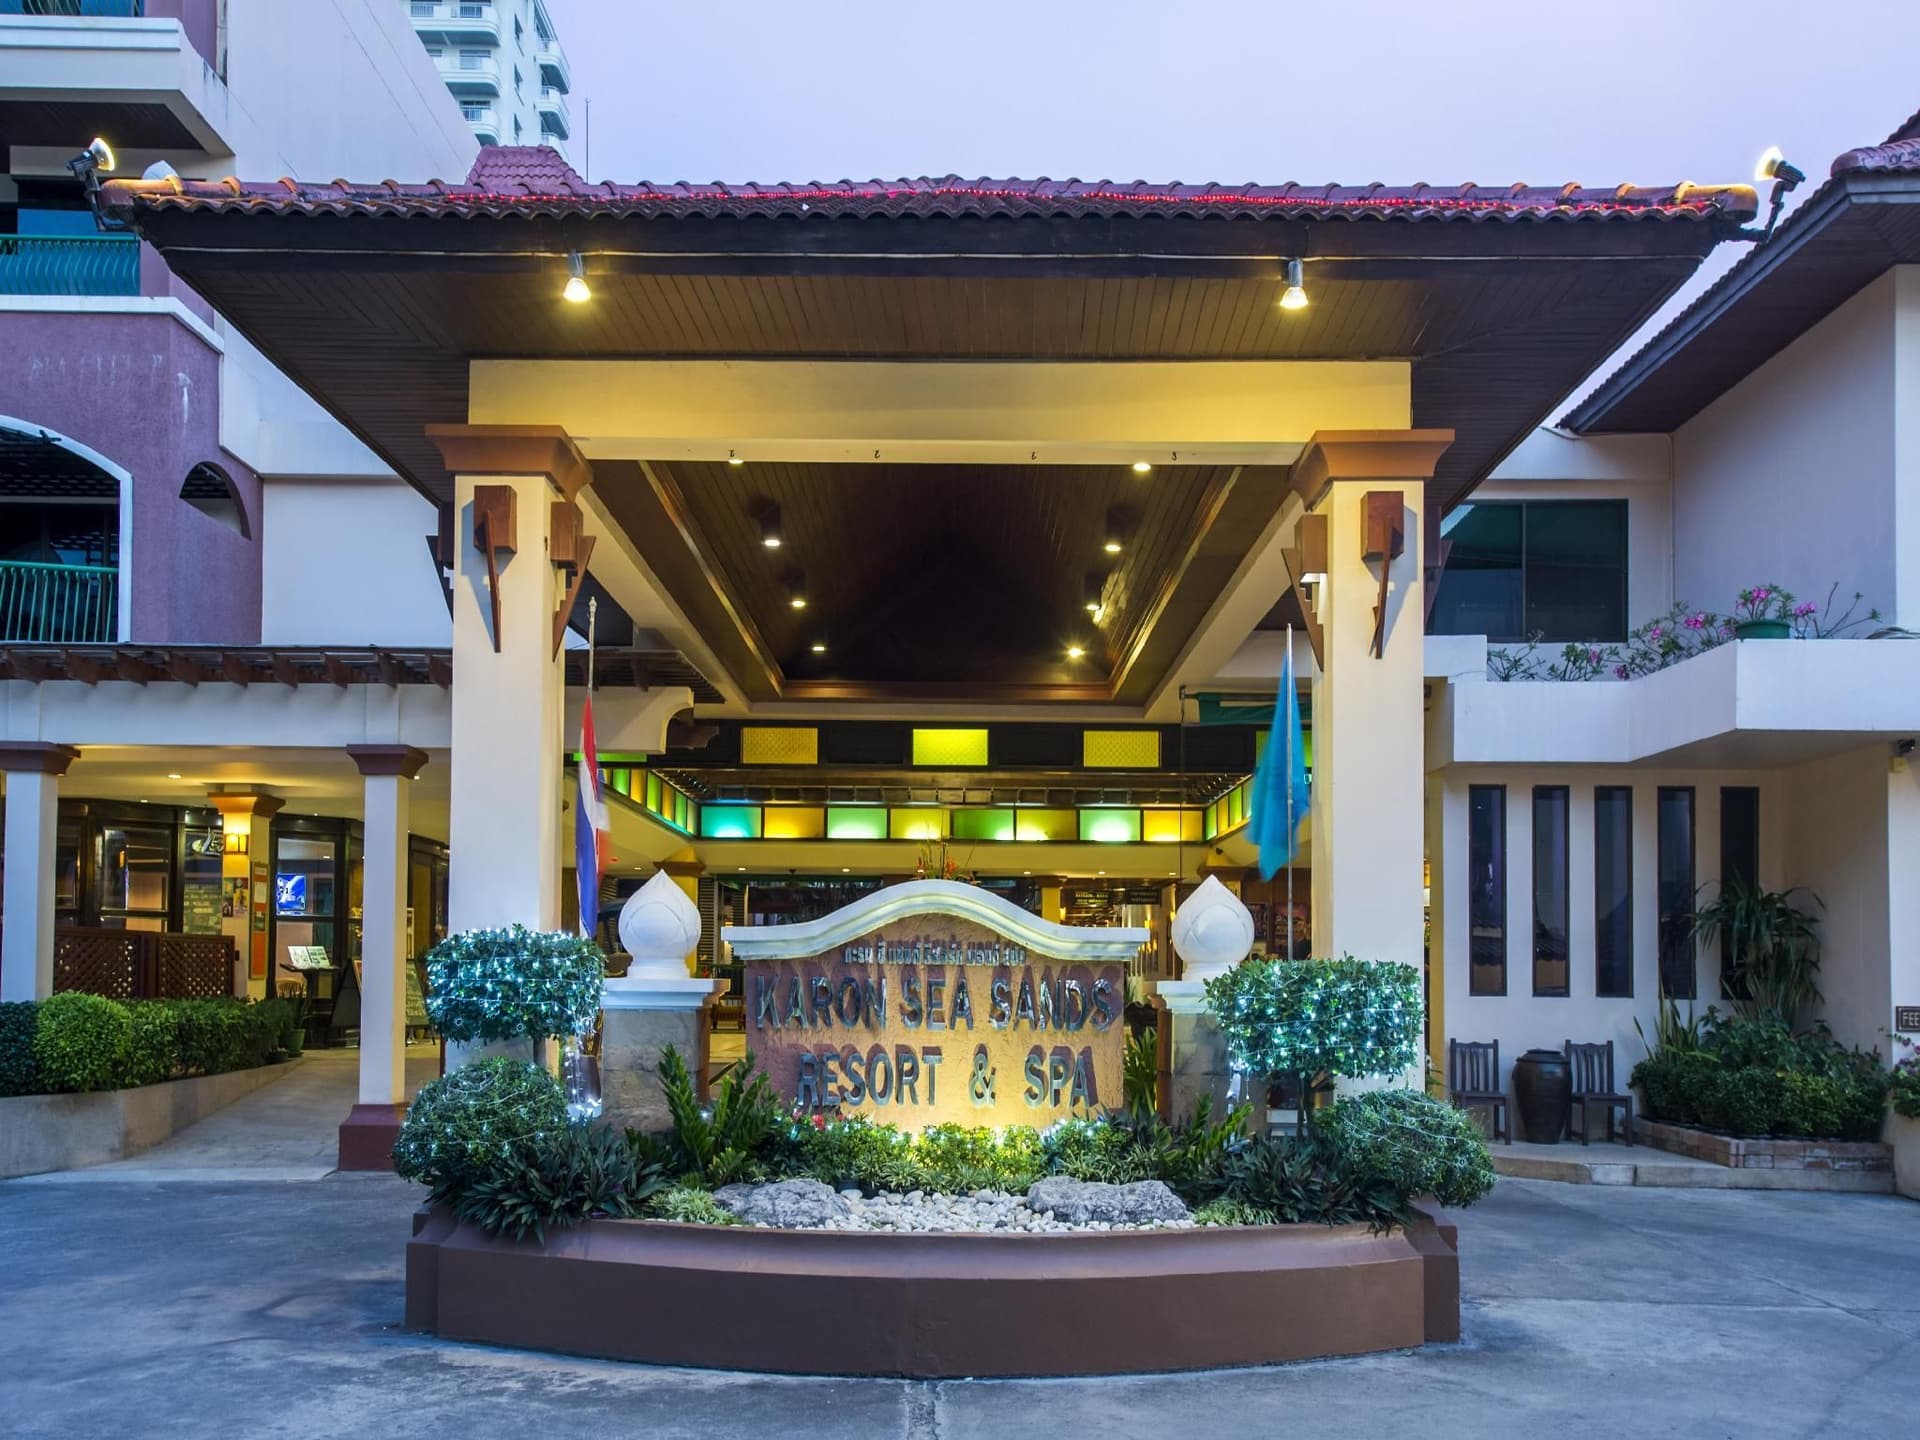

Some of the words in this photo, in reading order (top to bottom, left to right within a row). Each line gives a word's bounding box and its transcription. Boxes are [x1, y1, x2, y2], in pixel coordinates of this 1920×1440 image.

[755, 975, 887, 1030] KARON
[901, 977, 974, 1032] SEA
[990, 977, 1113, 1033] SANDS
[798, 1051, 943, 1107] RESORT
[967, 1053, 997, 1107] &
[1024, 1053, 1092, 1108] SPA
